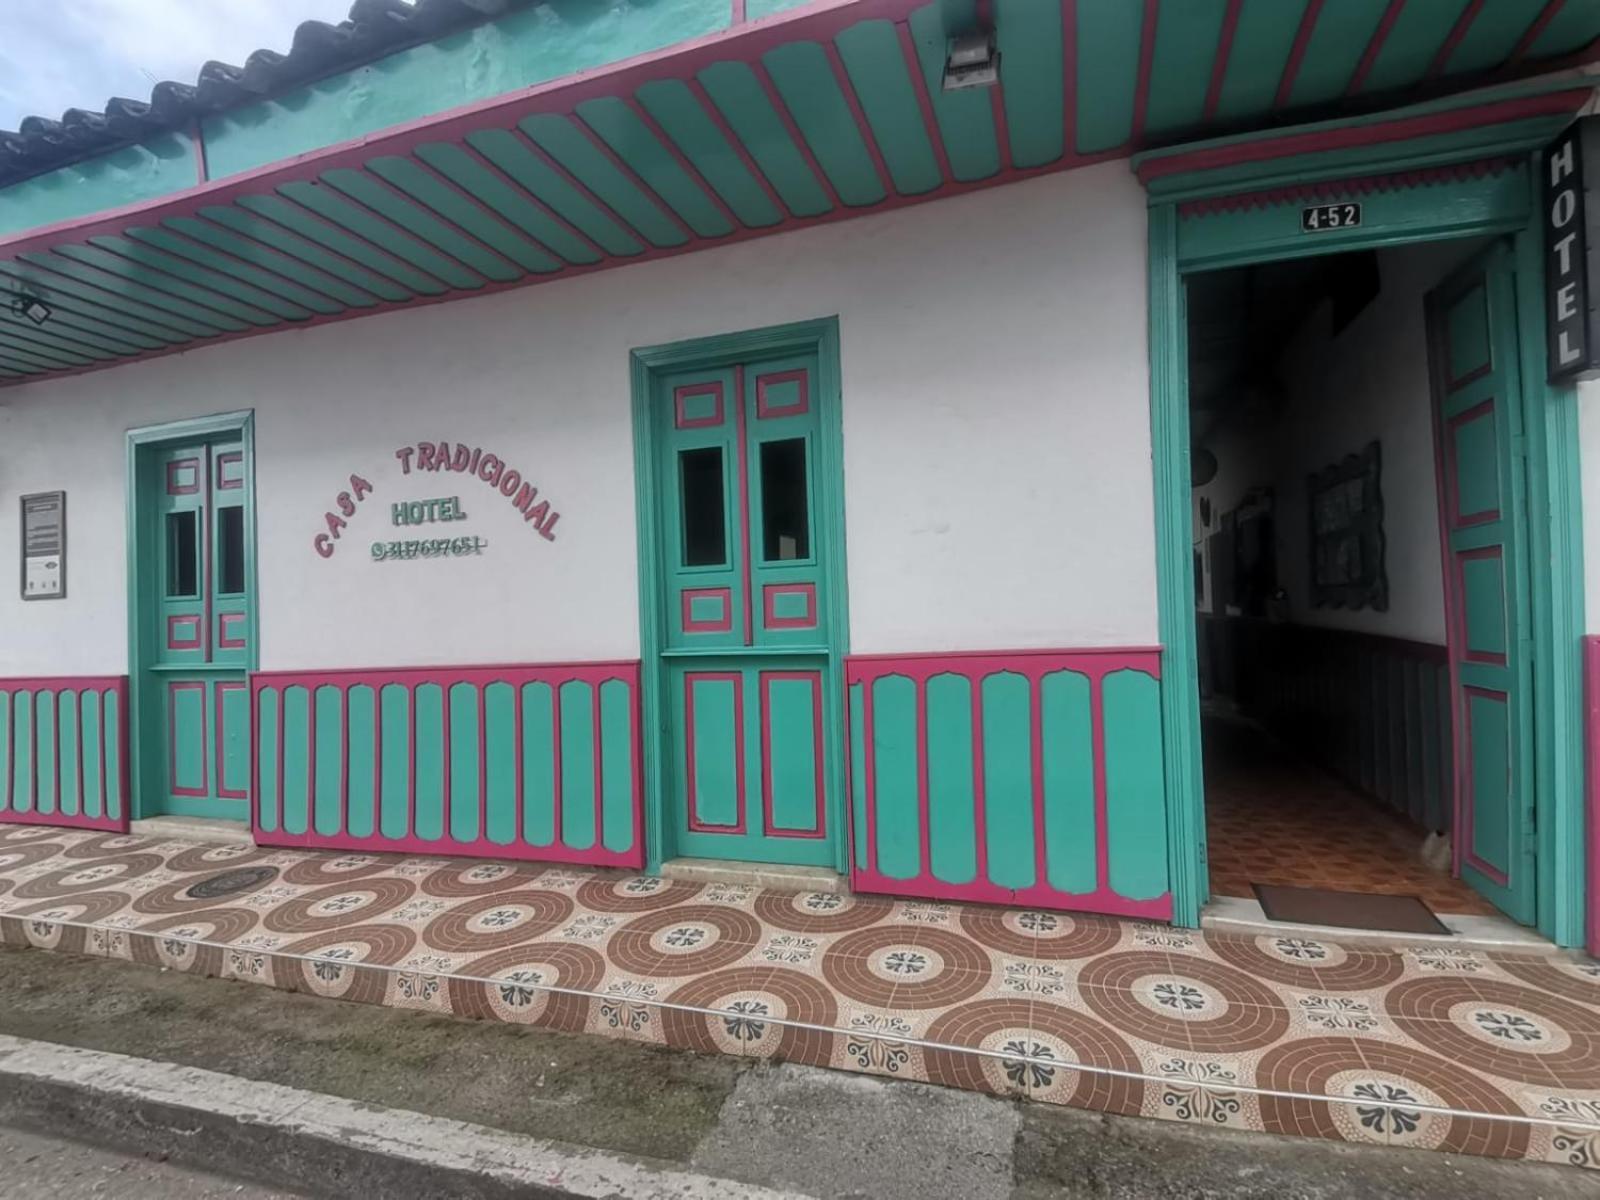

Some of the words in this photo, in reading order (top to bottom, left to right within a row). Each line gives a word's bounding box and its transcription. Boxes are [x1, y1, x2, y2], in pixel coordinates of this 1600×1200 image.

[1308, 206, 1355, 228] 4-52
[1551, 140, 1581, 366] HOTEL
[314, 474, 373, 558] CASA
[396, 441, 560, 542] TRADICIONAL
[391, 496, 467, 526] HOTEL
